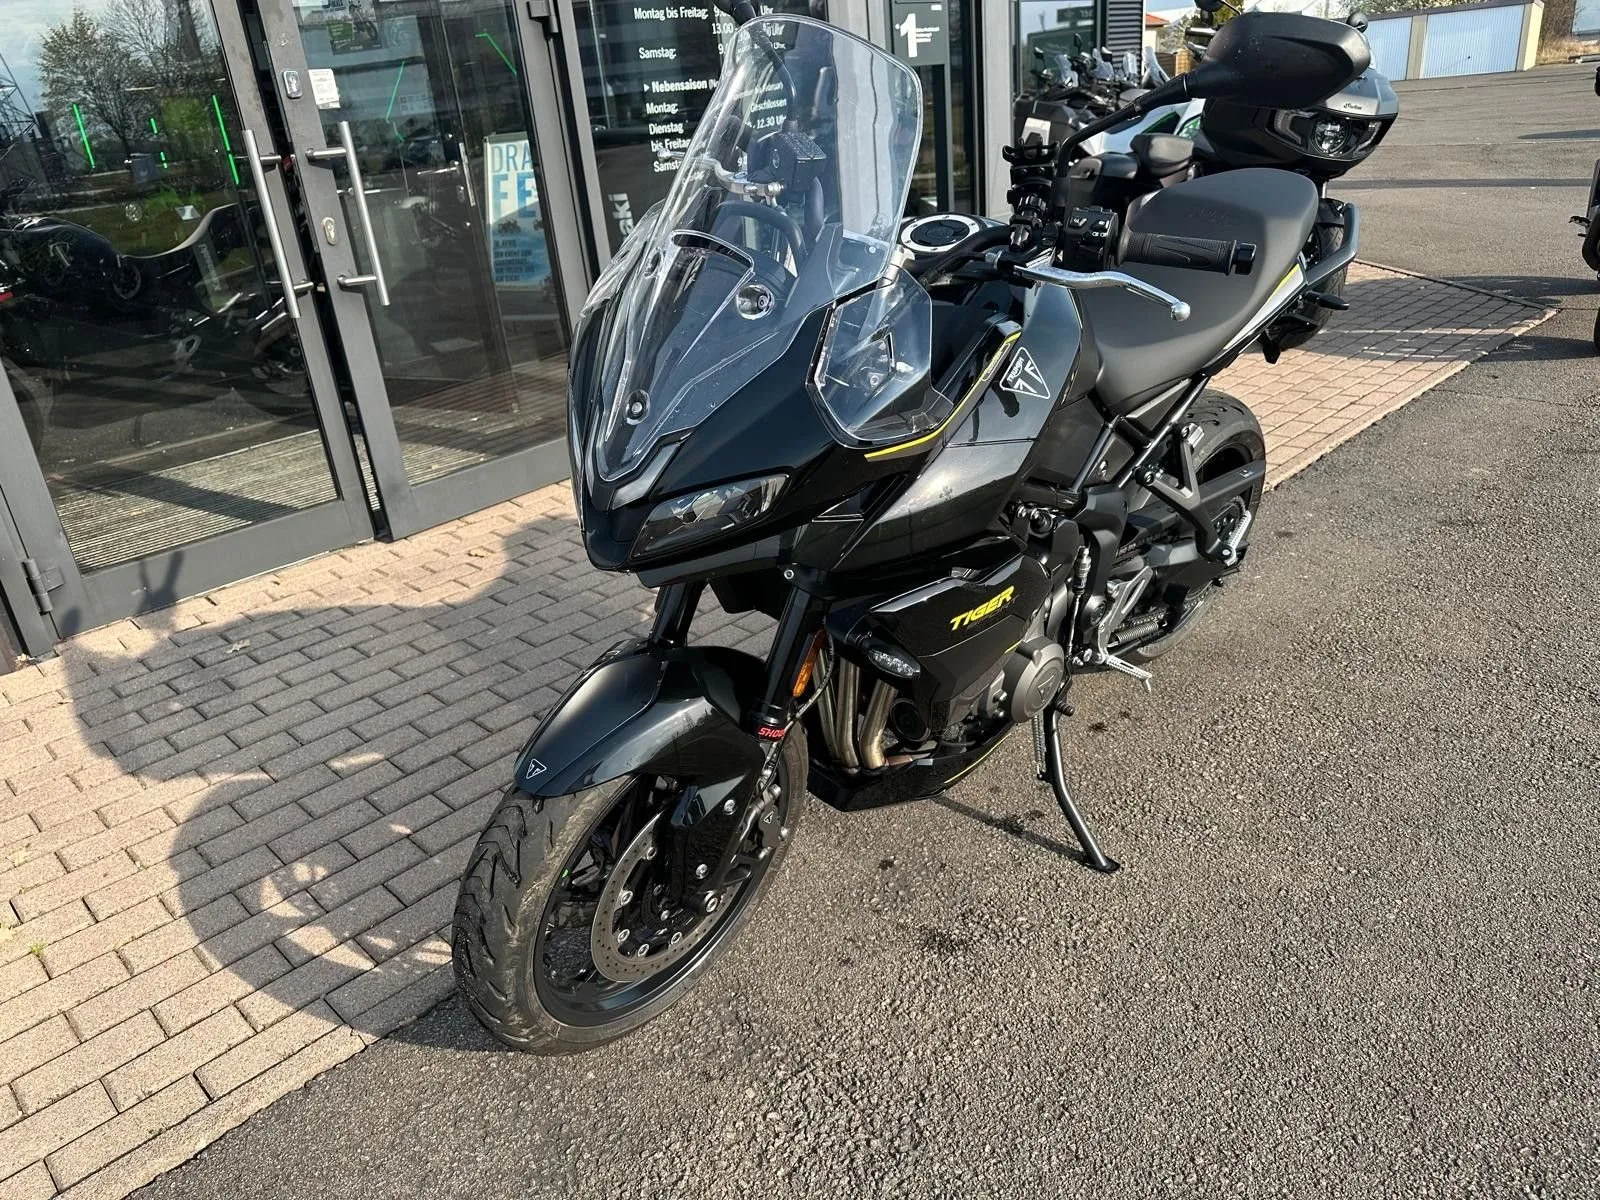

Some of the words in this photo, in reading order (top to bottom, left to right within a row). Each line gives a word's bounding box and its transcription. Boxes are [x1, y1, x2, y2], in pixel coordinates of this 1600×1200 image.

[634, 7, 665, 21] Montag
[667, 7, 678, 19] bis
[711, 23, 734, 35] 13.00
[639, 47, 677, 60] Samstag:
[651, 79, 708, 93] Nebensaison
[646, 102, 679, 114] Montag:
[649, 122, 684, 135] Dienstag
[651, 140, 664, 152] bis
[1007, 356, 1025, 382] TRIUMPH
[950, 585, 1015, 631] TIGER
[758, 727, 785, 738] SHO
